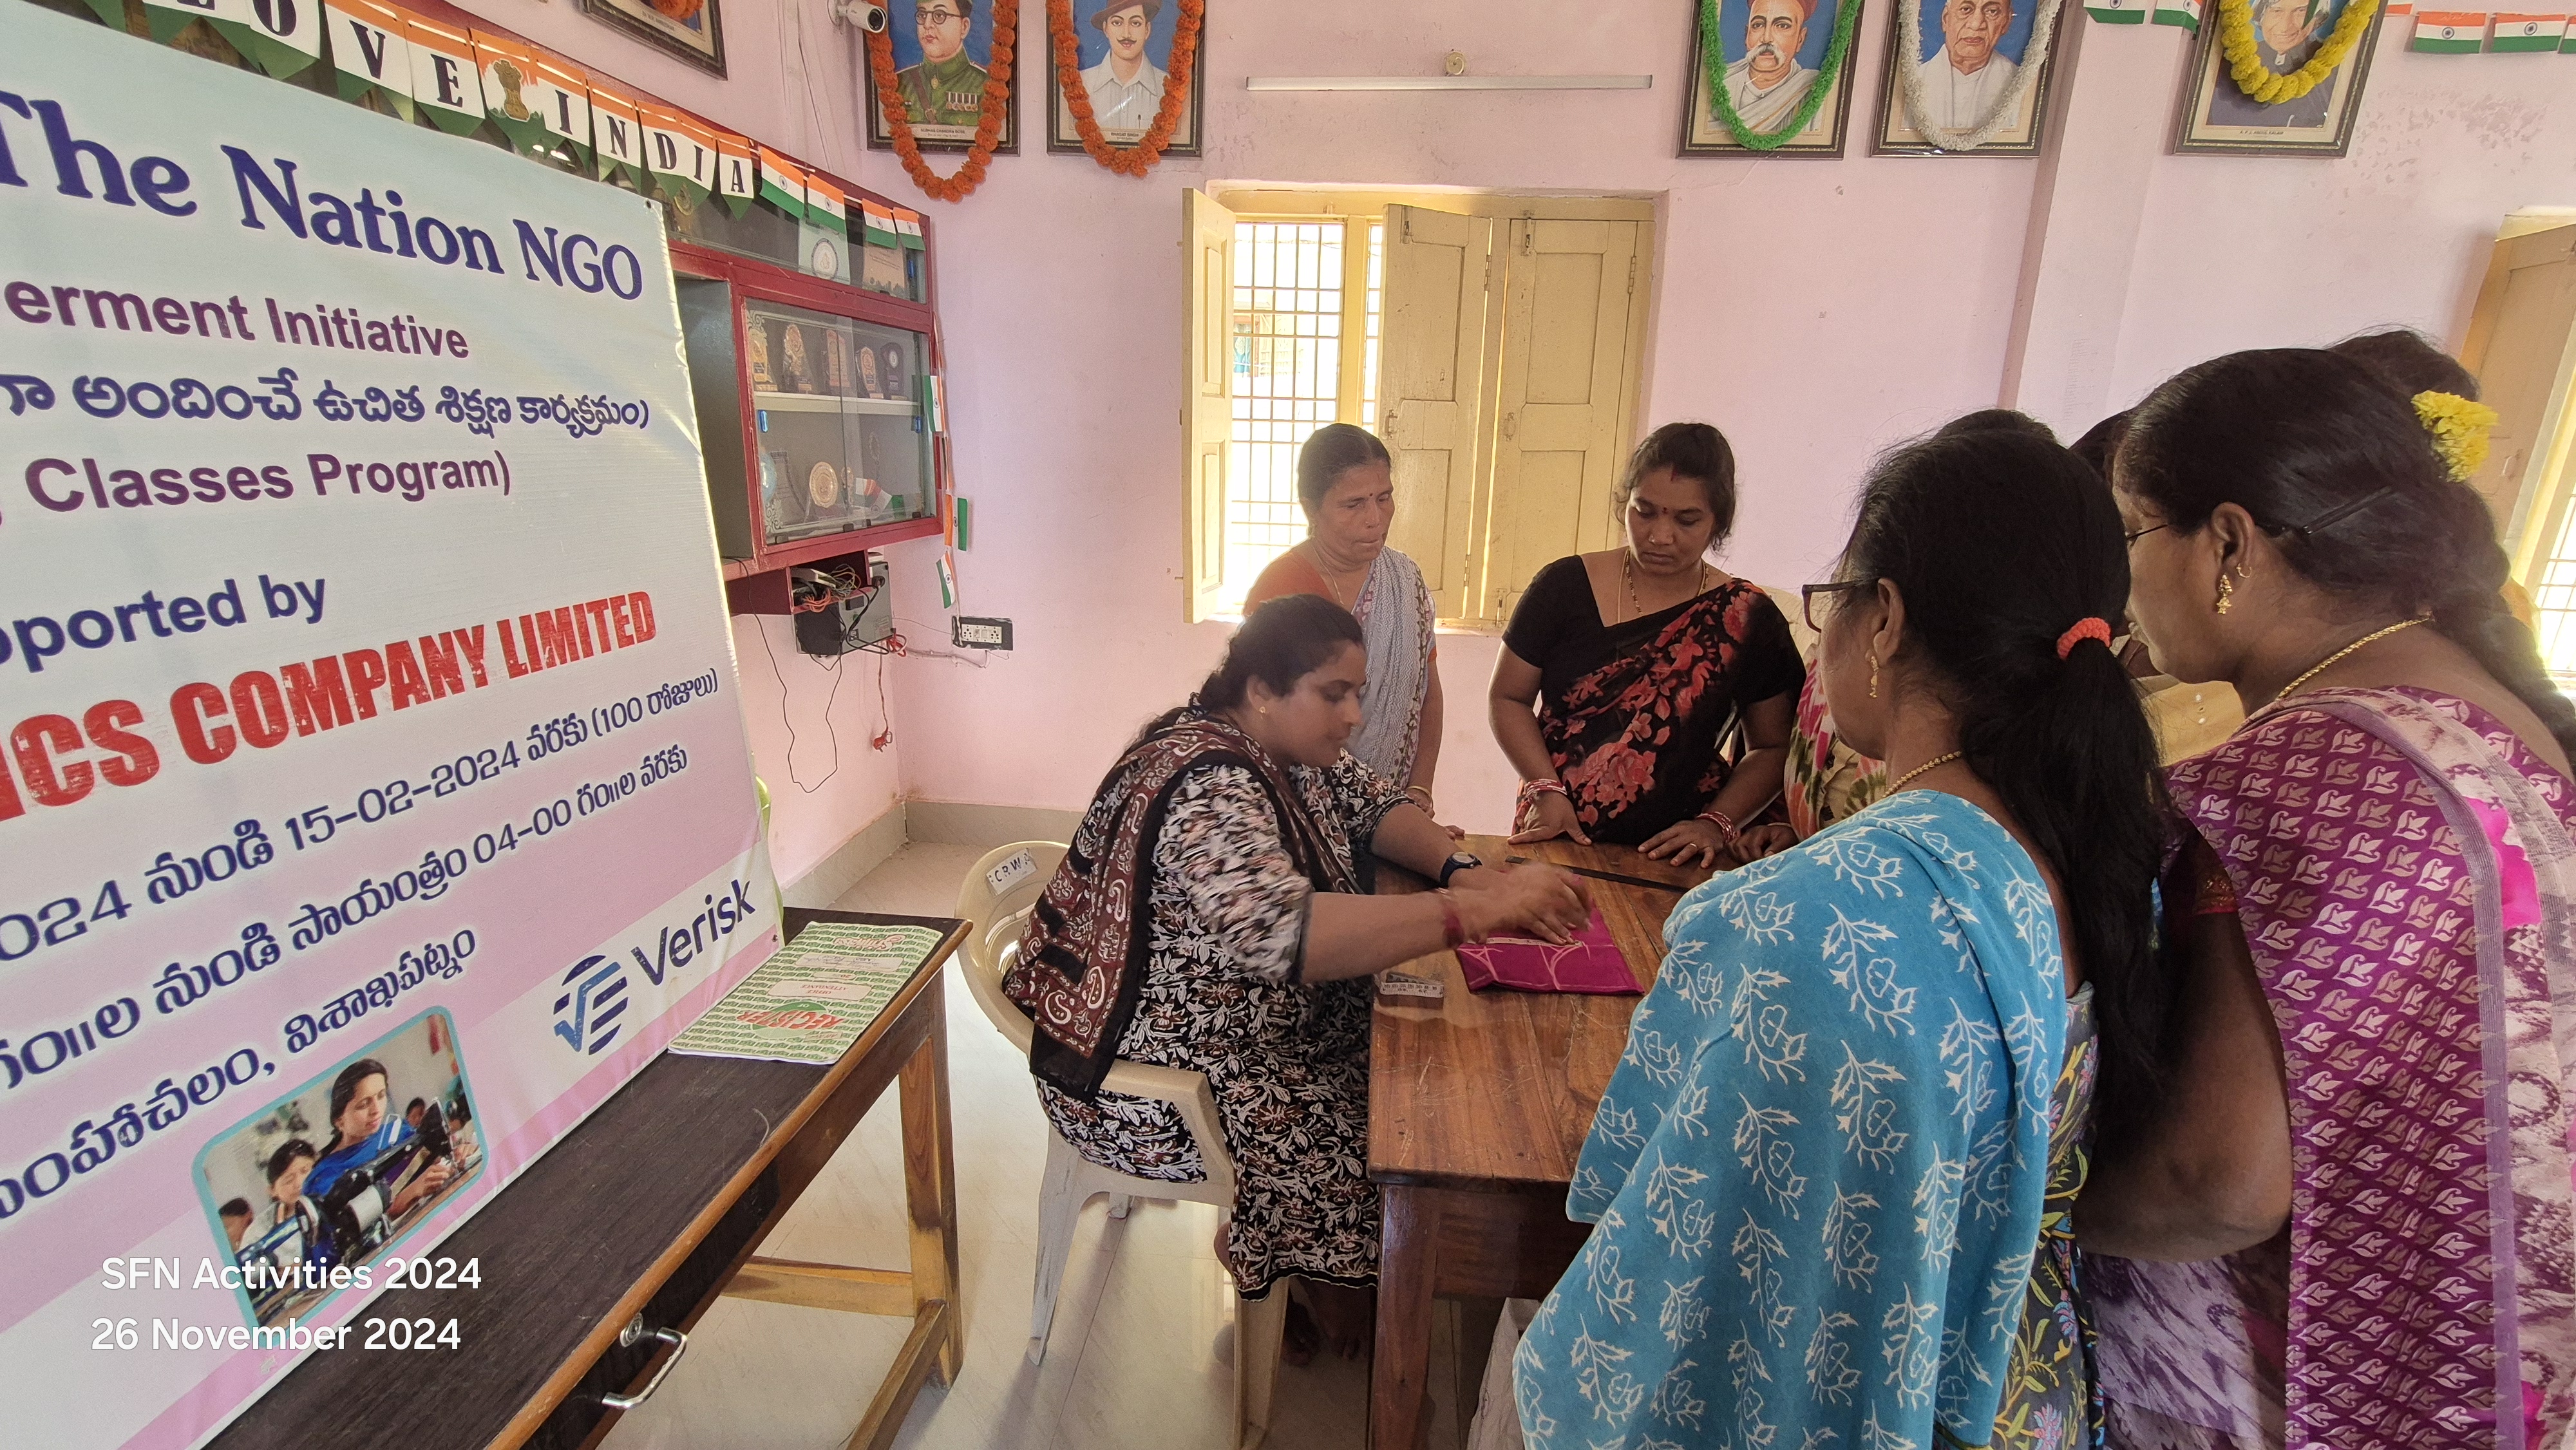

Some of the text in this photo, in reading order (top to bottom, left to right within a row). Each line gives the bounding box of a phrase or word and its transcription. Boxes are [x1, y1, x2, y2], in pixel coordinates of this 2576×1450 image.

[554, 88, 747, 194] INDIA
[220, 144, 506, 275] Nation
[513, 218, 643, 301] NGO
[4, 281, 469, 359] erment Initiative
[72, 367, 302, 420] అందించే
[312, 379, 426, 422] ఉచిత
[435, 385, 512, 439] శిక్షణ
[24, 450, 510, 513] Classes Program)
[258, 574, 325, 625] by
[169, 624, 488, 765] COMPANY
[497, 590, 656, 679] LIMITED
[144, 818, 274, 905] నుండి
[285, 740, 520, 851] 15-02-2024
[526, 712, 588, 762] వరకు
[591, 697, 643, 738] (100
[152, 921, 281, 1015] నుండి
[473, 798, 573, 864] 04-00
[639, 744, 688, 787] వరకు
[630, 879, 756, 986] Verisk
[736, 1010, 845, 1030] REGISTER
